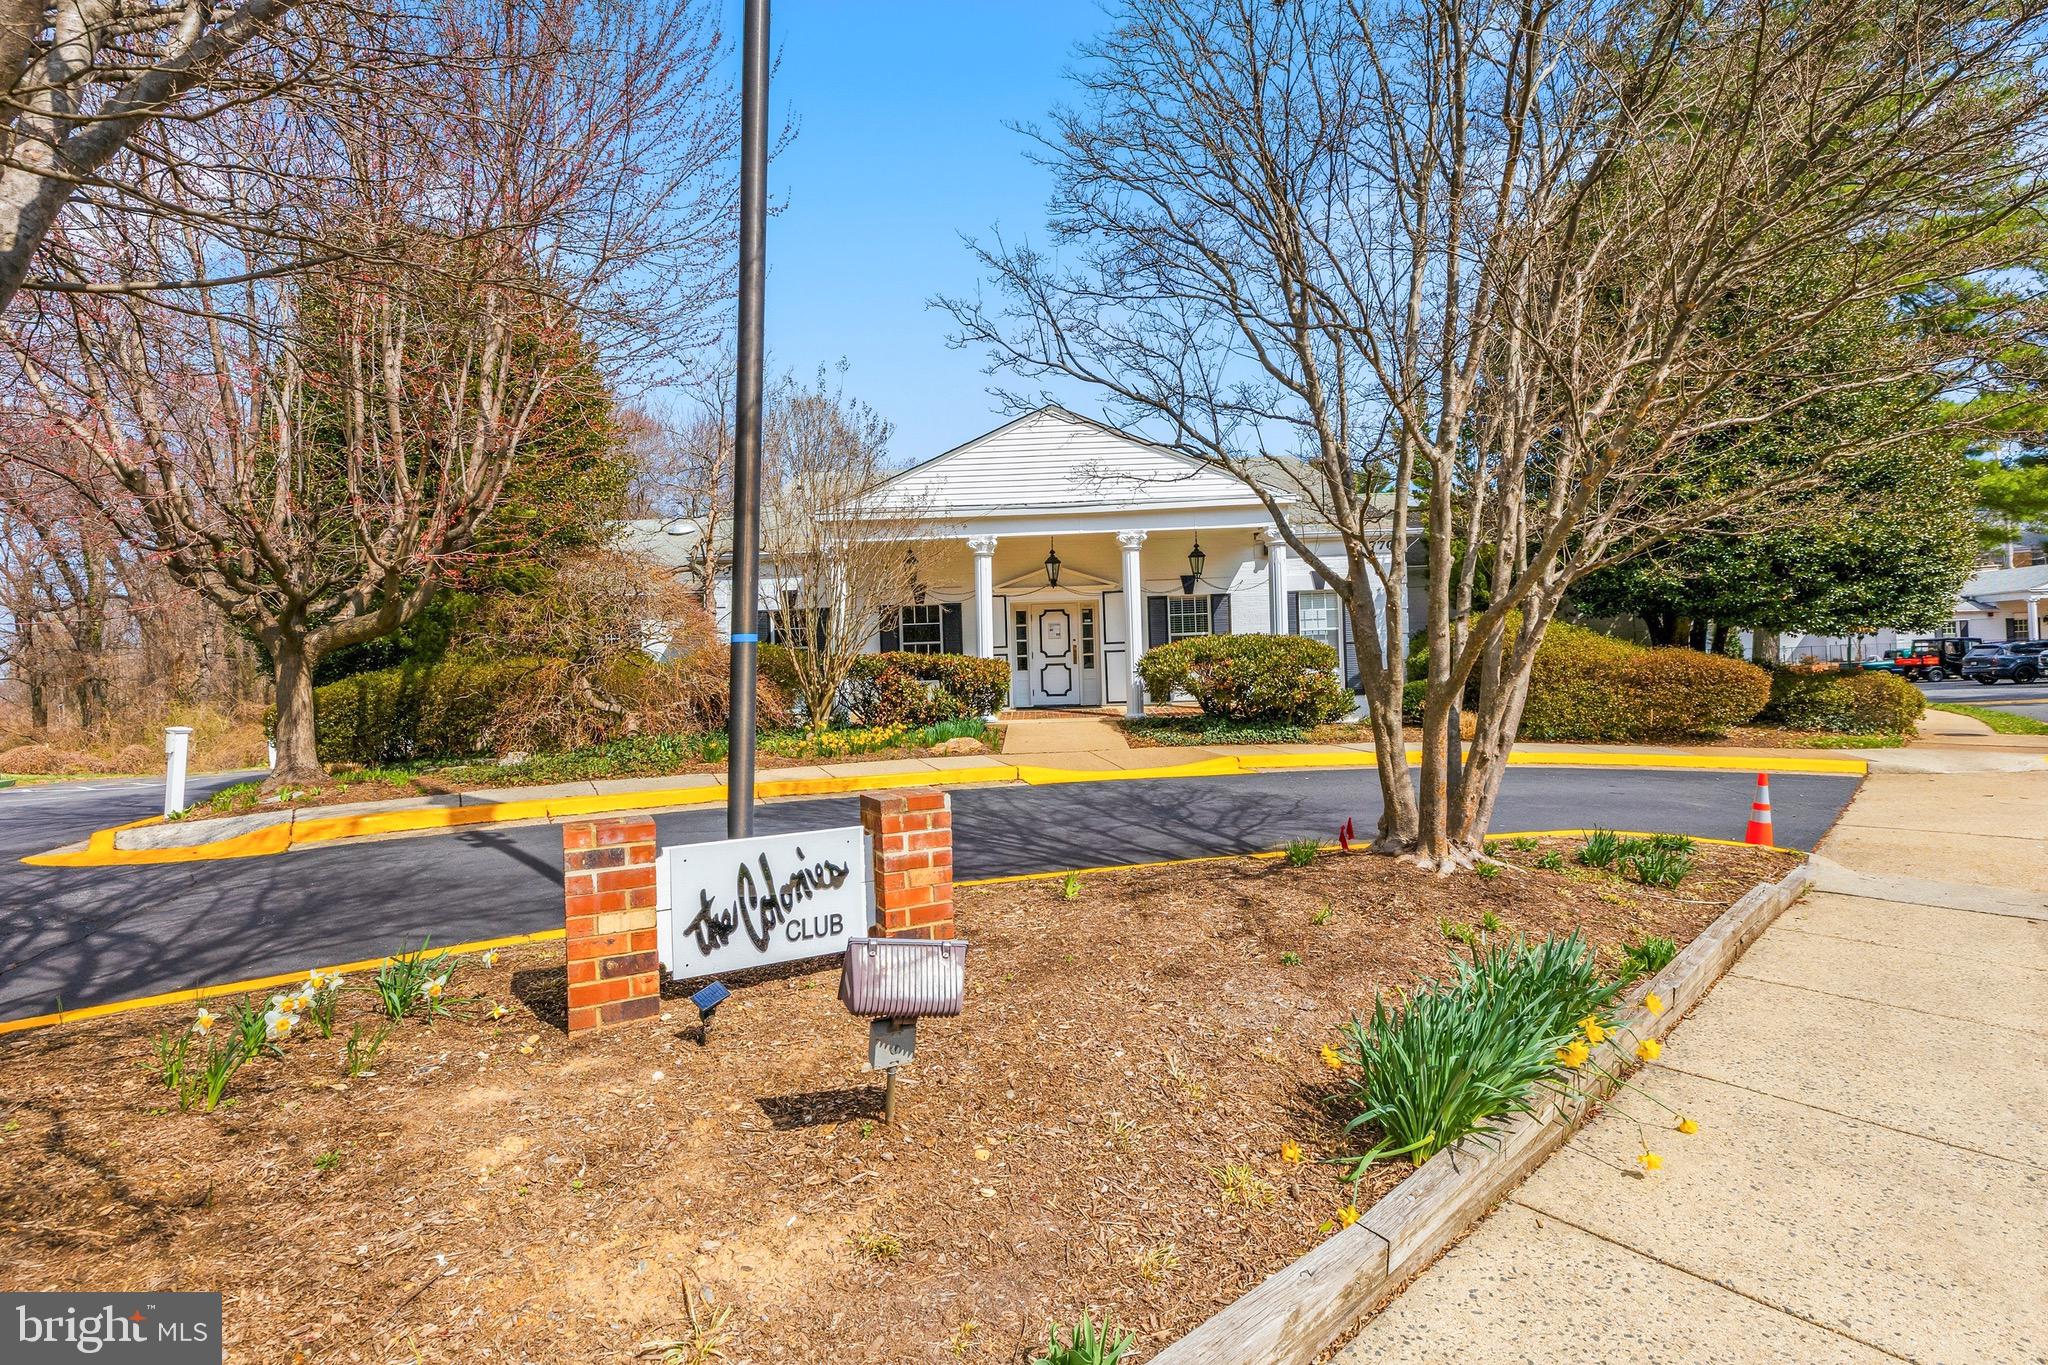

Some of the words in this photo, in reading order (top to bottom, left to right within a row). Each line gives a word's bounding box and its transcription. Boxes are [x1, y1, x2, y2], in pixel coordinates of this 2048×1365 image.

[683, 888, 737, 956] the
[737, 846, 849, 953] Colonies
[785, 912, 844, 942] CLUB
